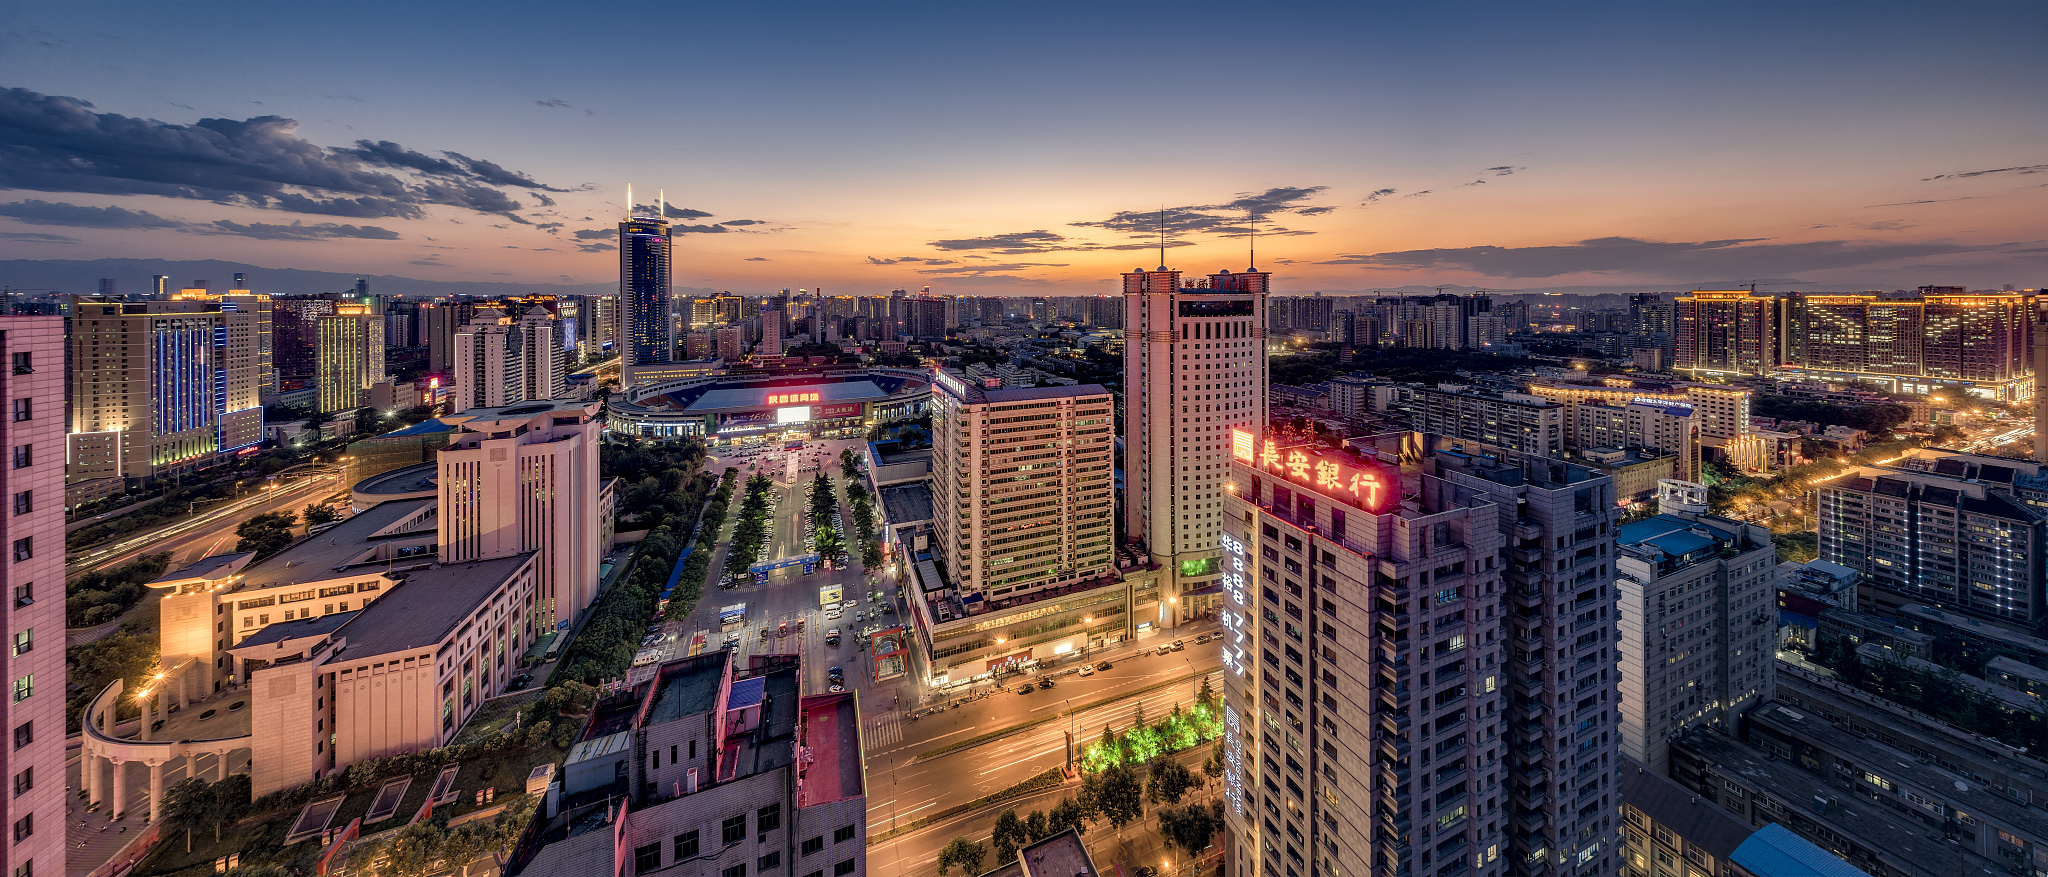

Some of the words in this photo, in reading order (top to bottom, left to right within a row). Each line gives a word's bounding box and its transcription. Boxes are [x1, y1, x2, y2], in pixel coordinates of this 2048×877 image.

[1259, 439, 1382, 508] 長安銀行
[1222, 534, 1234, 669] 华裕机票
